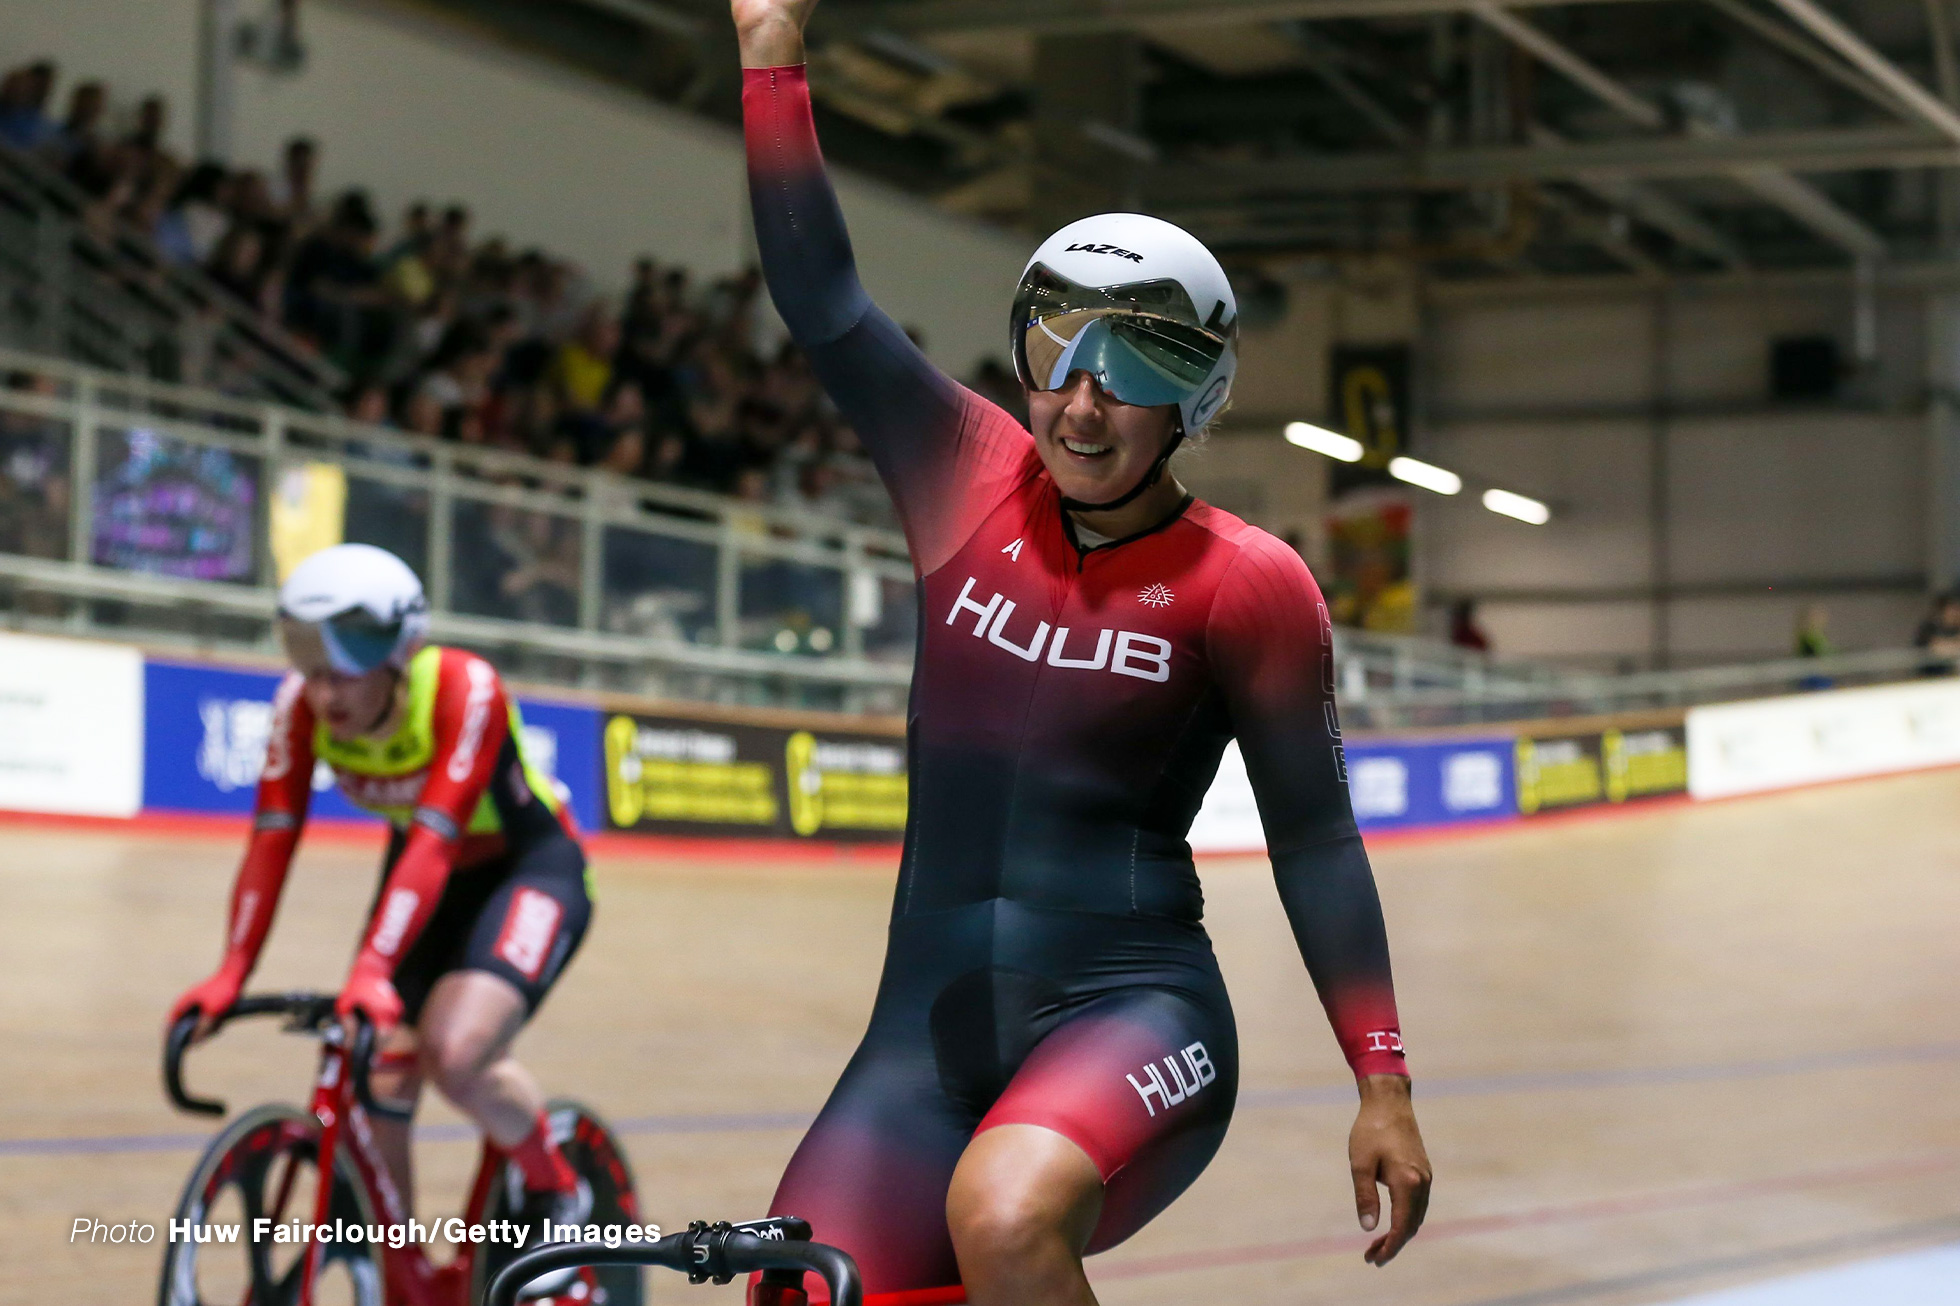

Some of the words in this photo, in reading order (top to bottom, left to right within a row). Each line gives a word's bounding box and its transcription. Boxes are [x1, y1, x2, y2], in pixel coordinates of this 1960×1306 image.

[1064, 243, 1144, 264] LAZER
[945, 576, 1173, 684] HUUB
[1125, 1040, 1216, 1118] HUUB
